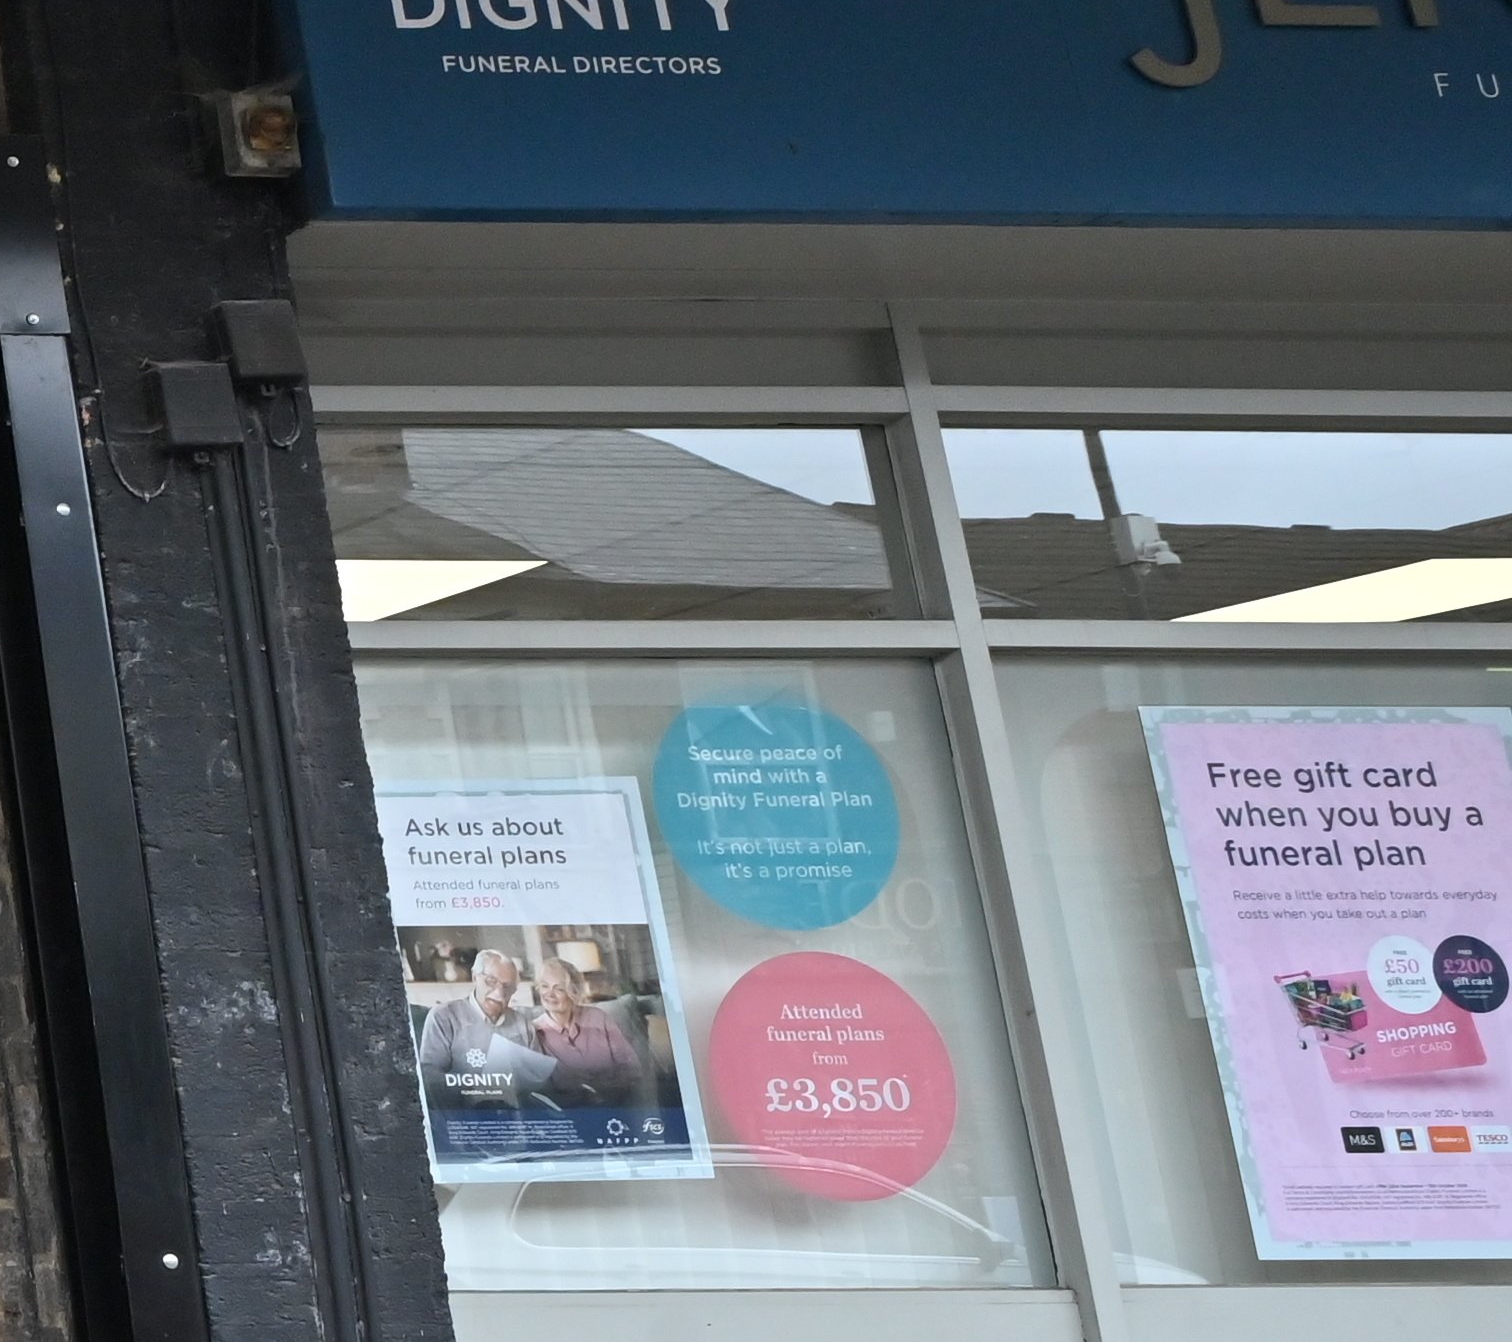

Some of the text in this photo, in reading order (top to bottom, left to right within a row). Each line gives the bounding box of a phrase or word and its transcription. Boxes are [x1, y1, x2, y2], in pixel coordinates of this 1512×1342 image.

[442, 54, 722, 75] FUNERAL DIRECTORS
[688, 744, 843, 764] Secure peace of
[714, 768, 828, 784] mind with a
[1207, 761, 1438, 793] Free gift card
[677, 792, 873, 810] Dignity Funeral Plan
[1216, 800, 1484, 832] when you buy a
[405, 817, 565, 837] Ask us about
[697, 839, 872, 856] It's not just a plan,
[1224, 839, 1427, 871] funeral plan
[408, 846, 567, 868] funeral plans
[725, 862, 853, 880] it's a promise
[413, 879, 560, 891] Attended funeral plans
[415, 897, 446, 909] from
[1233, 889, 1498, 903] Receive a little extra help towards everyday
[1237, 908, 1427, 922] costs when you take out a plan
[1385, 958, 1420, 974] £50
[1443, 958, 1494, 975] £200
[1387, 976, 1427, 987] gift card
[1452, 976, 1493, 987] gift card
[780, 1004, 863, 1020] Attended
[767, 1026, 885, 1045] funeral plans
[1376, 1021, 1457, 1043] SHOPPING
[1392, 1040, 1453, 1058] GIFT CARD
[812, 1052, 848, 1065] from
[445, 1073, 513, 1087] DIGNITY
[1349, 1134, 1376, 1146] M&S
[1476, 1134, 1509, 1142] TESCO
